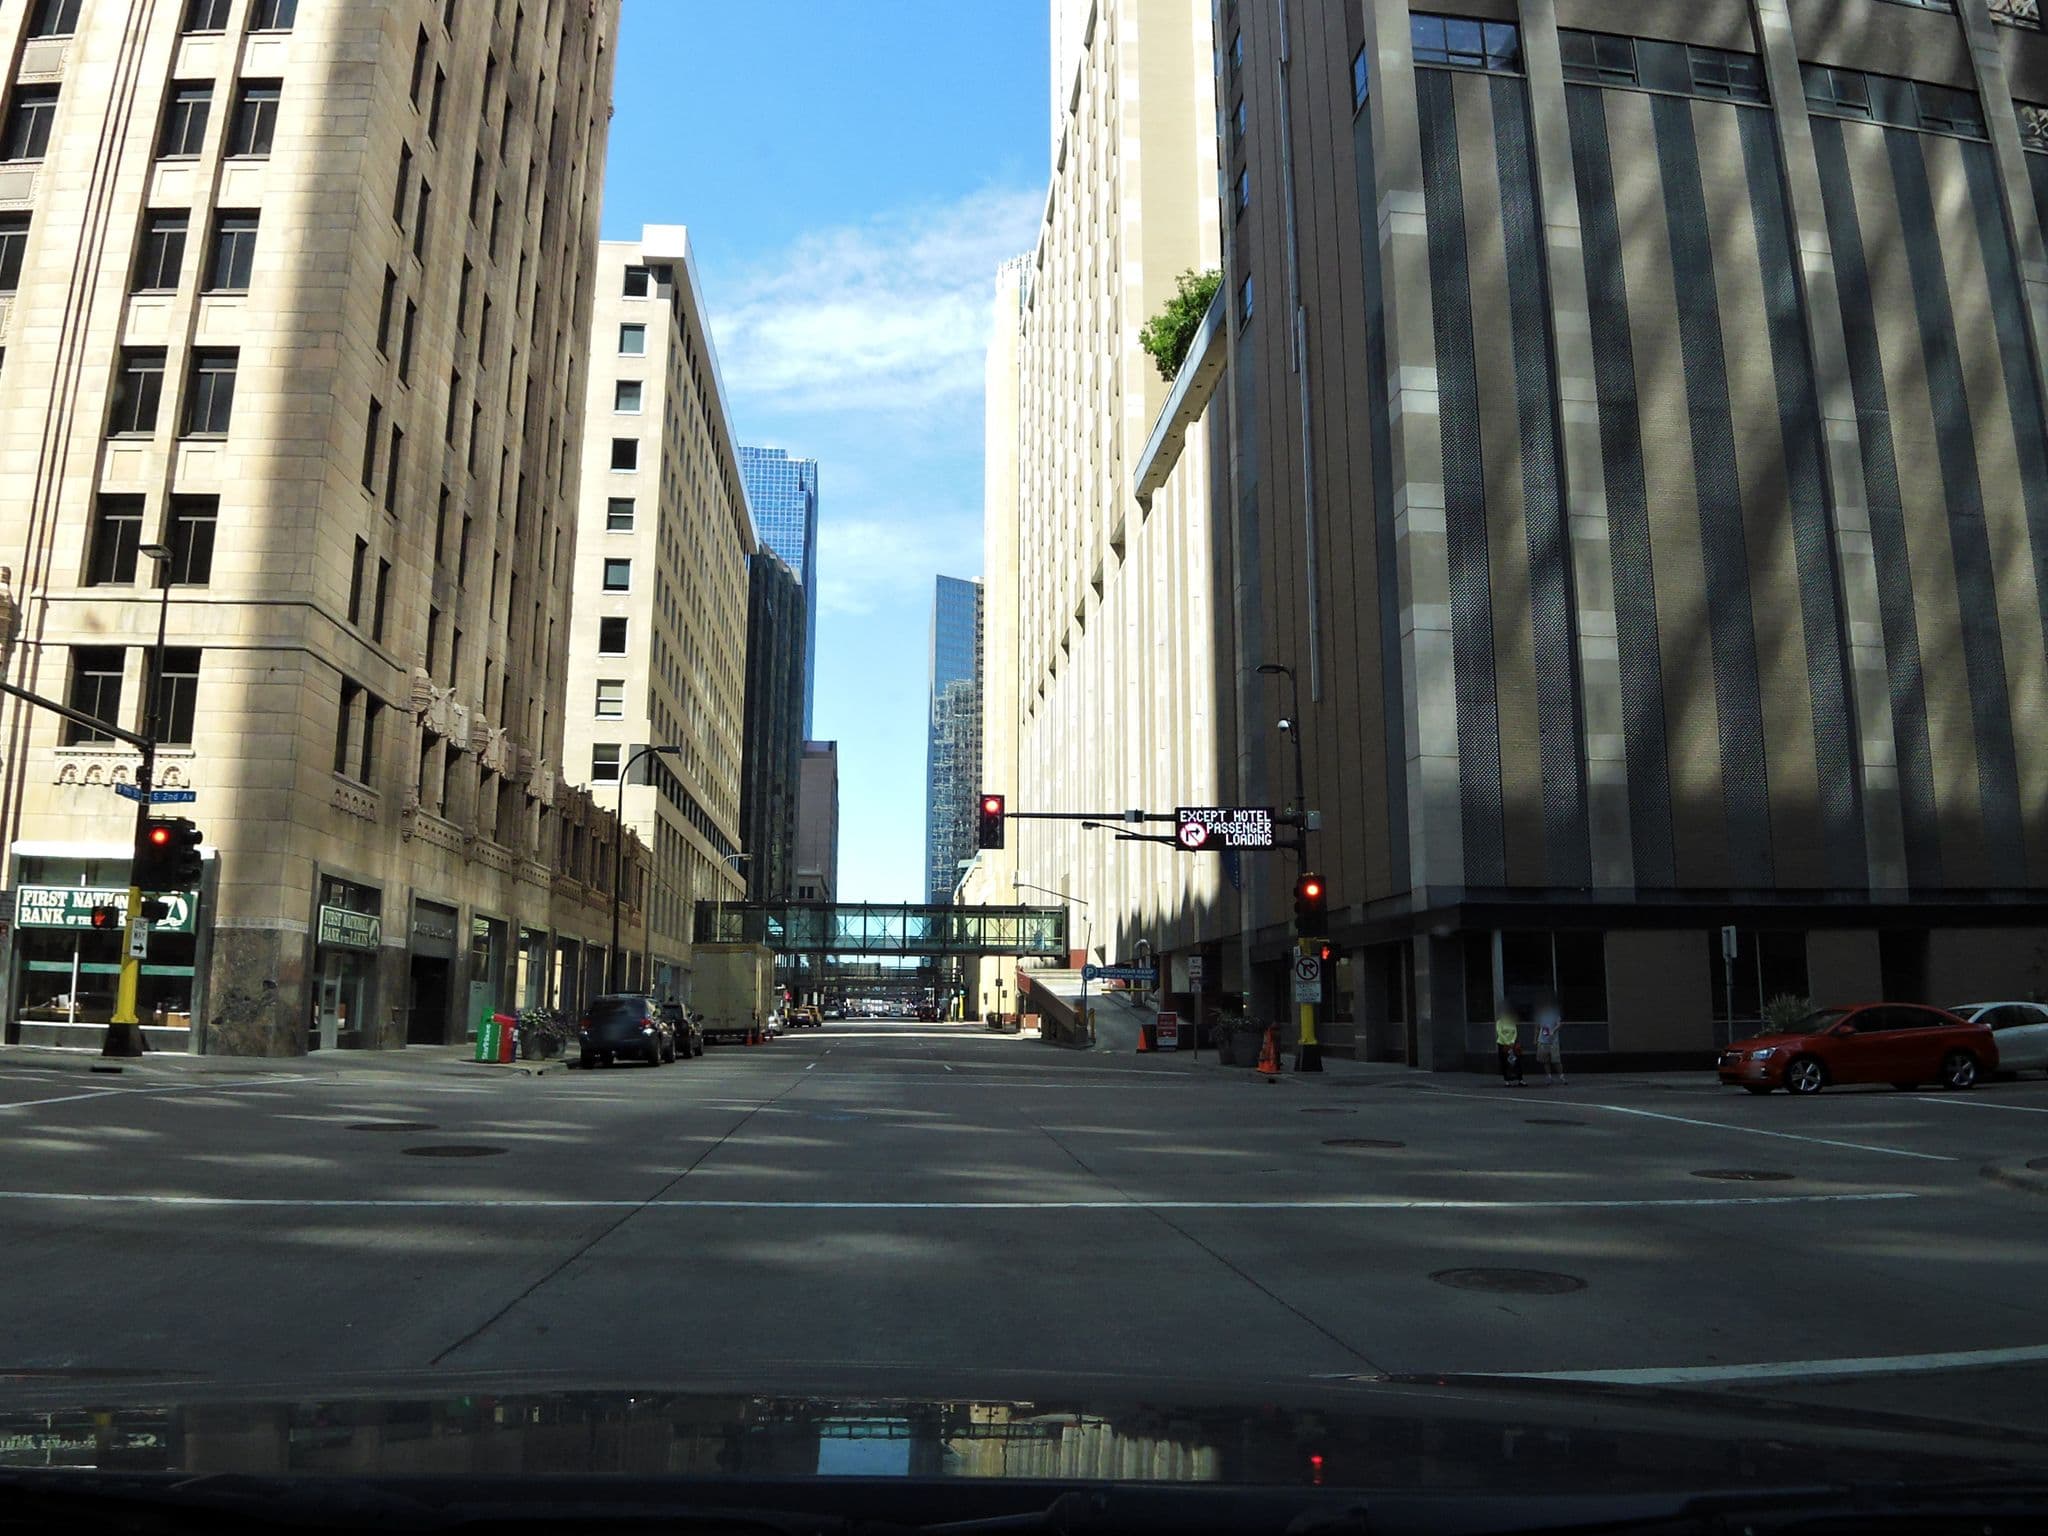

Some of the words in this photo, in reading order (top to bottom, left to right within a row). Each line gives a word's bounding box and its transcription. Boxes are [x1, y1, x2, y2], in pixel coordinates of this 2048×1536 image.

[153, 792, 159, 801] S
[162, 792, 179, 801] 2nd
[1180, 810, 1226, 822] EXCEPT
[1233, 810, 1271, 822] HOTEL
[1206, 822, 1272, 834] PASSENGER
[1225, 834, 1272, 846] LOADING
[21, 889, 68, 907] FIRST
[72, 892, 129, 910] NATION
[20, 907, 65, 925] BANK
[323, 910, 342, 927] FIRST
[322, 926, 341, 943] BANK
